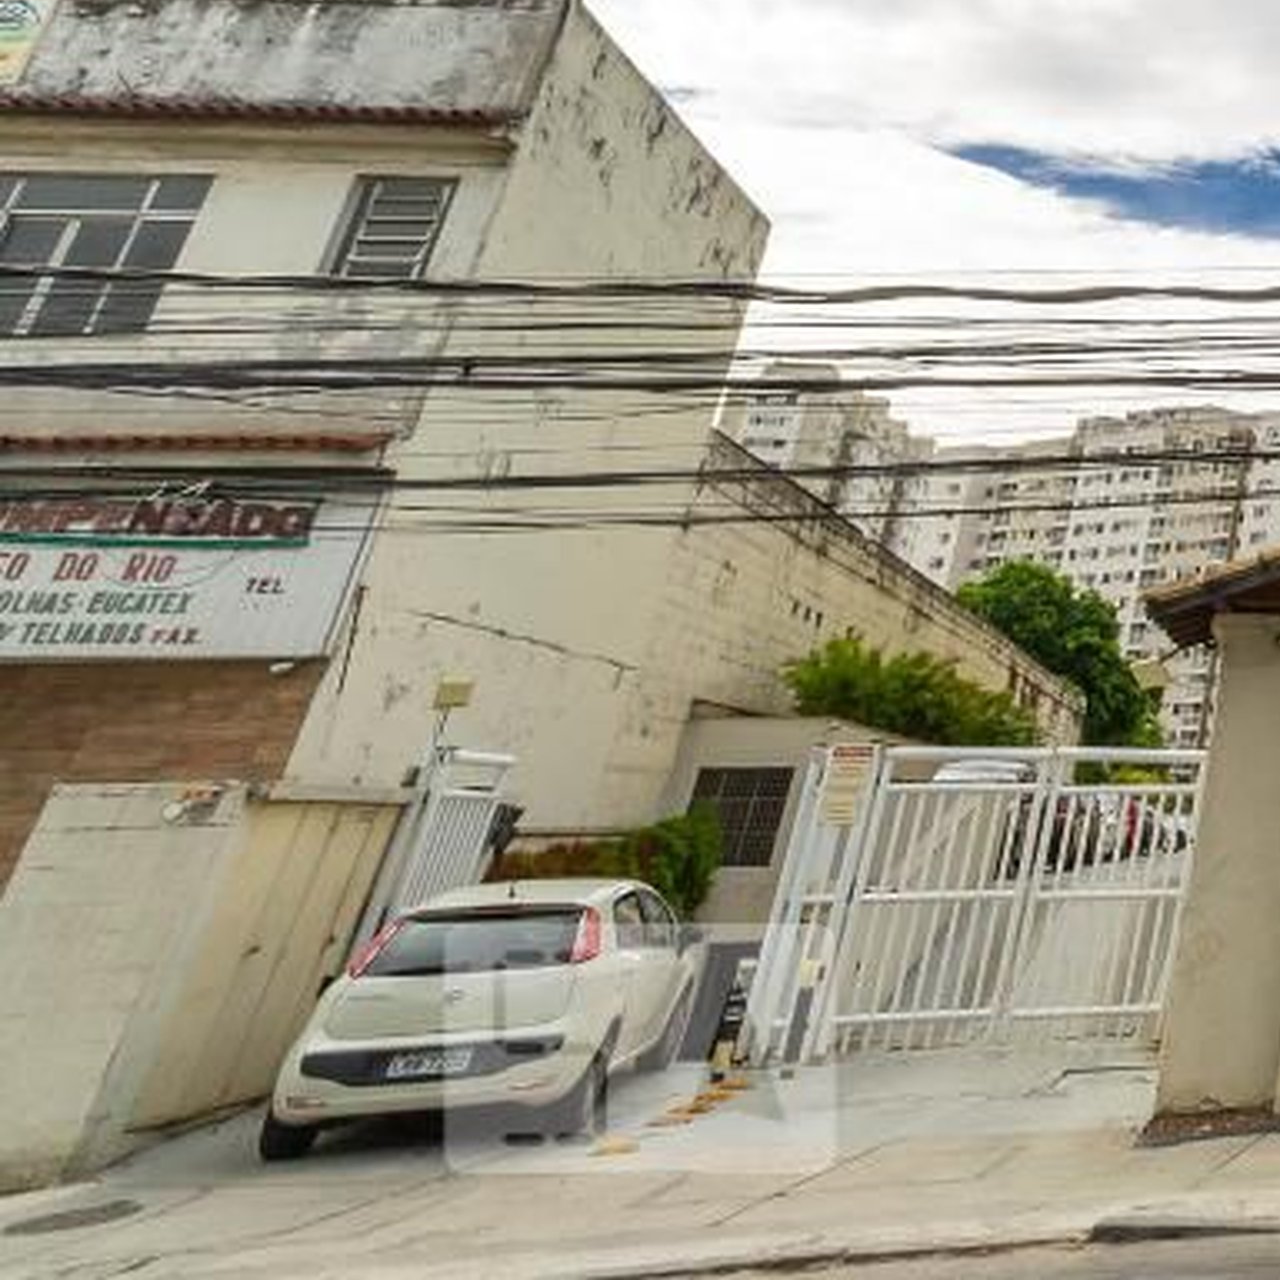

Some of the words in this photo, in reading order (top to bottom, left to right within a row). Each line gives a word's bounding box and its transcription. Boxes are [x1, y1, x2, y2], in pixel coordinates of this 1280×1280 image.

[53, 552, 99, 581] DO
[121, 553, 177, 582] RIO
[86, 591, 194, 614] EUCATEX
[19, 622, 146, 644] TELHADOS
